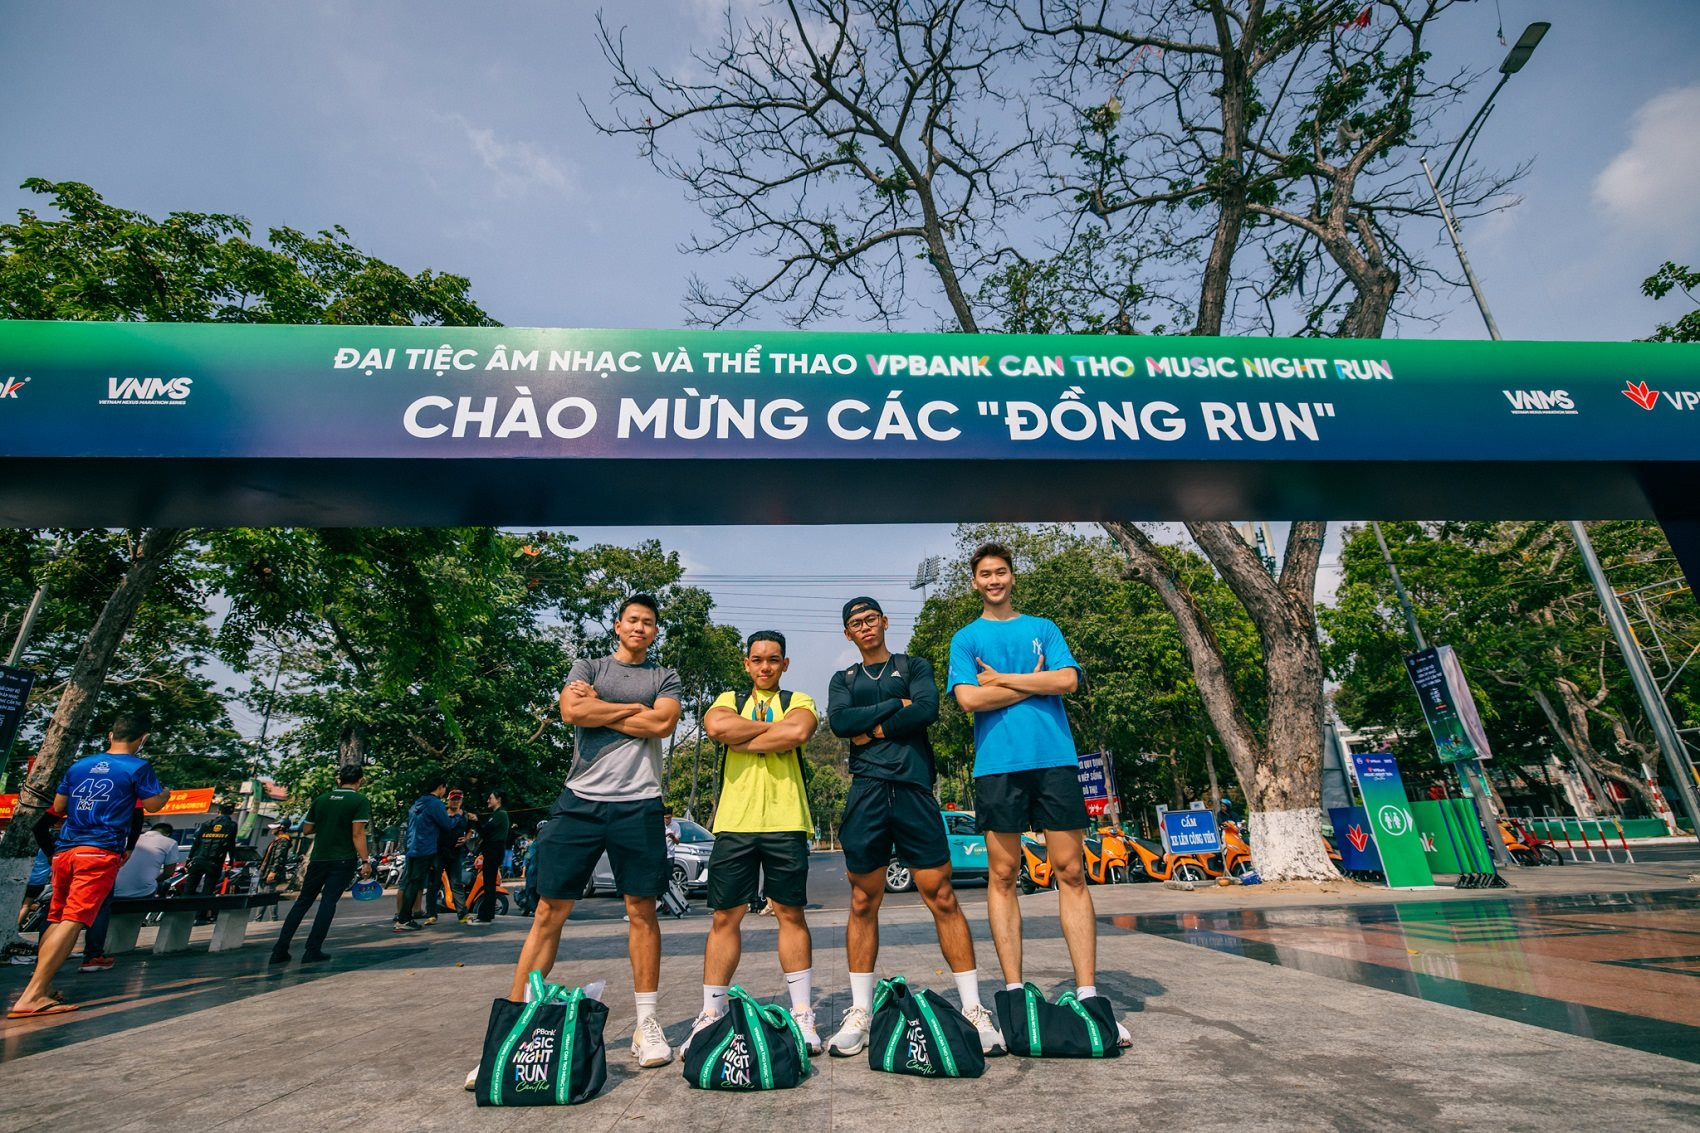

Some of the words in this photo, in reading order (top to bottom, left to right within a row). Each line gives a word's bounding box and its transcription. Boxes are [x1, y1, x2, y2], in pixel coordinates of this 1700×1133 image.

[334, 347, 396, 376] ĐẠI
[405, 344, 479, 377] TIỆC
[484, 344, 539, 371] ÂM
[548, 350, 642, 379] NHẠC
[652, 346, 694, 373] VÀ
[703, 344, 763, 374] THỂ
[769, 353, 858, 375] THAO
[866, 354, 993, 377] VPBANK
[999, 355, 1065, 378] CAN
[1070, 355, 1135, 378] THO
[1145, 356, 1239, 379] MUSIC
[1242, 357, 1328, 379] NIGHT
[1334, 359, 1394, 380] RUN
[108, 377, 193, 400] VNMS
[1502, 389, 1575, 410] VNMS
[403, 385, 598, 439] CHÀO
[617, 387, 808, 440] MỪNG
[827, 390, 962, 442] CÁC
[977, 386, 1186, 442] "ĐỒNG
[1200, 402, 1336, 442] RUN"
[71, 778, 114, 801] 42
[76, 800, 95, 811] KM
[1181, 814, 1198, 828] CẤM
[512, 1049, 553, 1063] NIGHT
[515, 1064, 549, 1082] RUN
[721, 1062, 751, 1085] RUN
